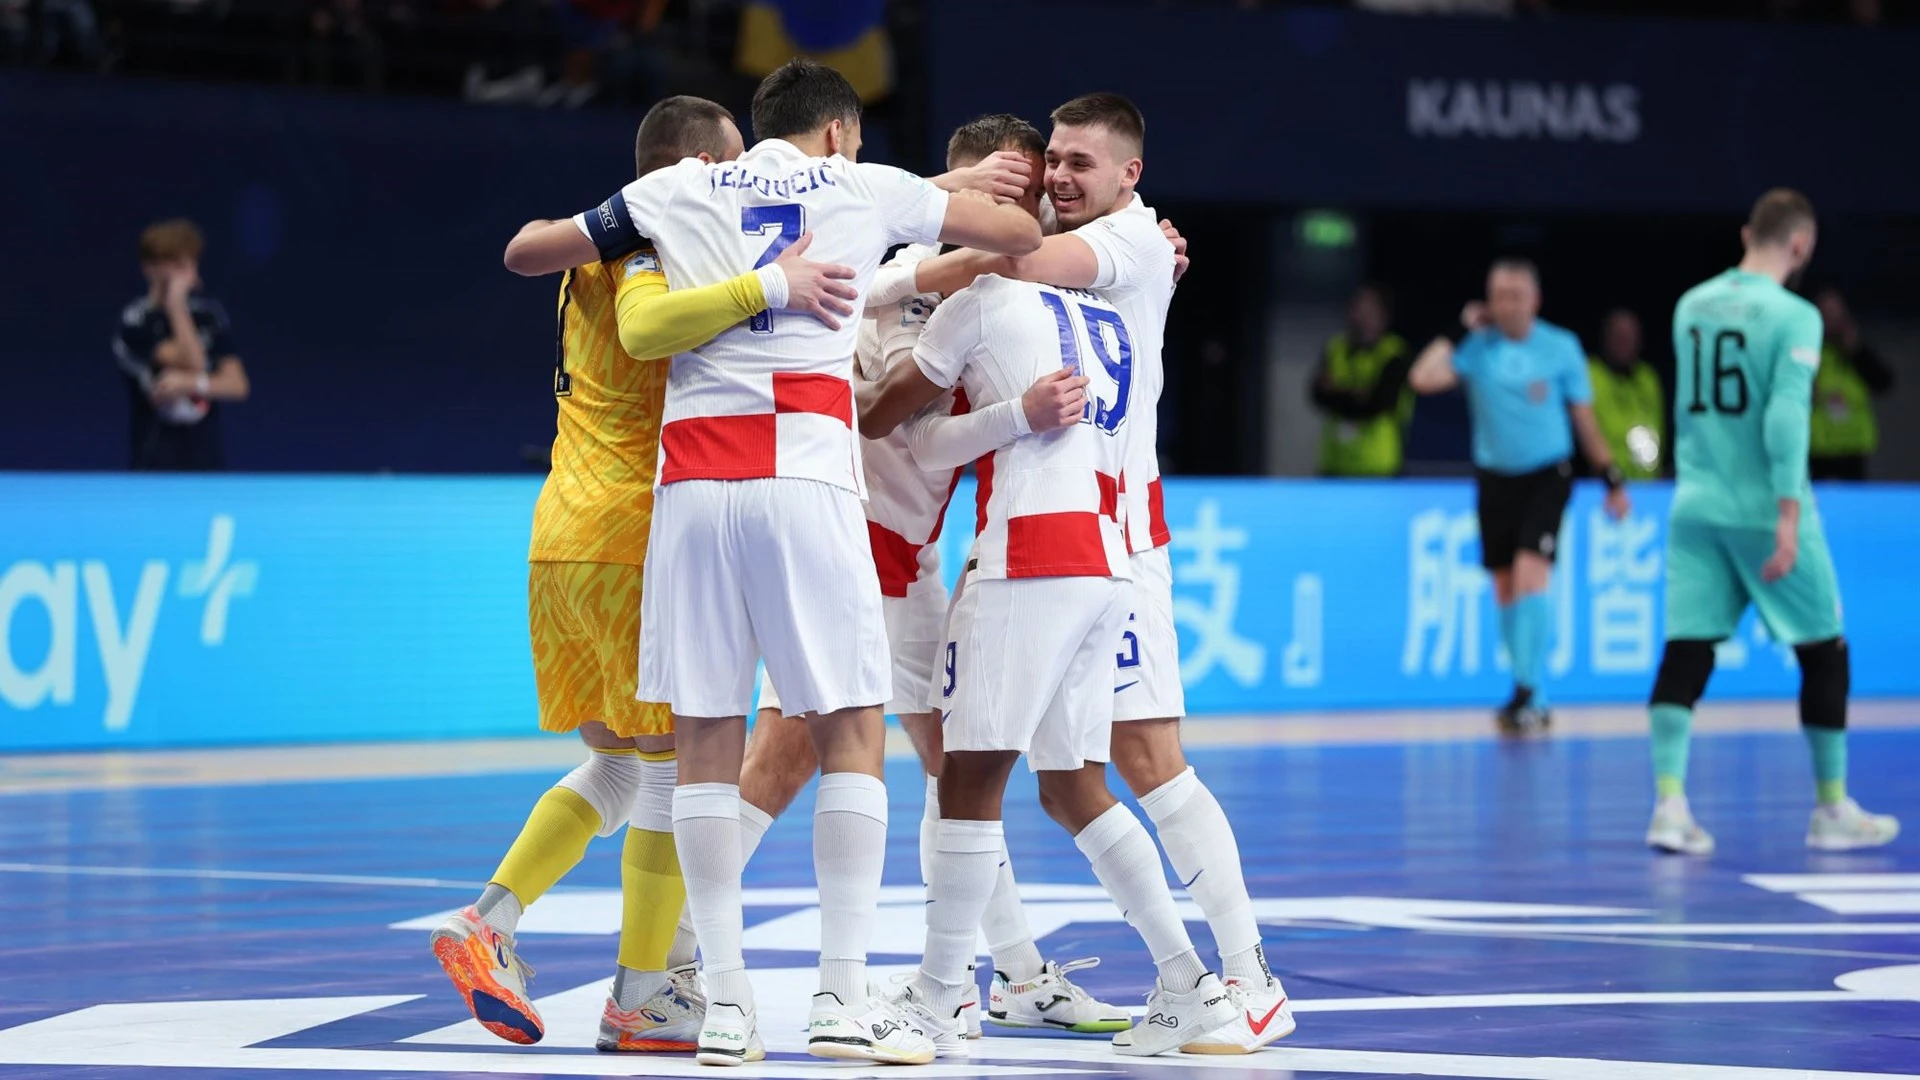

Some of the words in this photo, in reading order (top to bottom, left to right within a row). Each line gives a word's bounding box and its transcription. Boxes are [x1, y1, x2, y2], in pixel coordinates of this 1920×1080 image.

[1406, 77, 1642, 142] KAUNAS
[741, 203, 806, 334] 7
[1039, 290, 1136, 437] 19
[1688, 325, 1748, 416] 16
